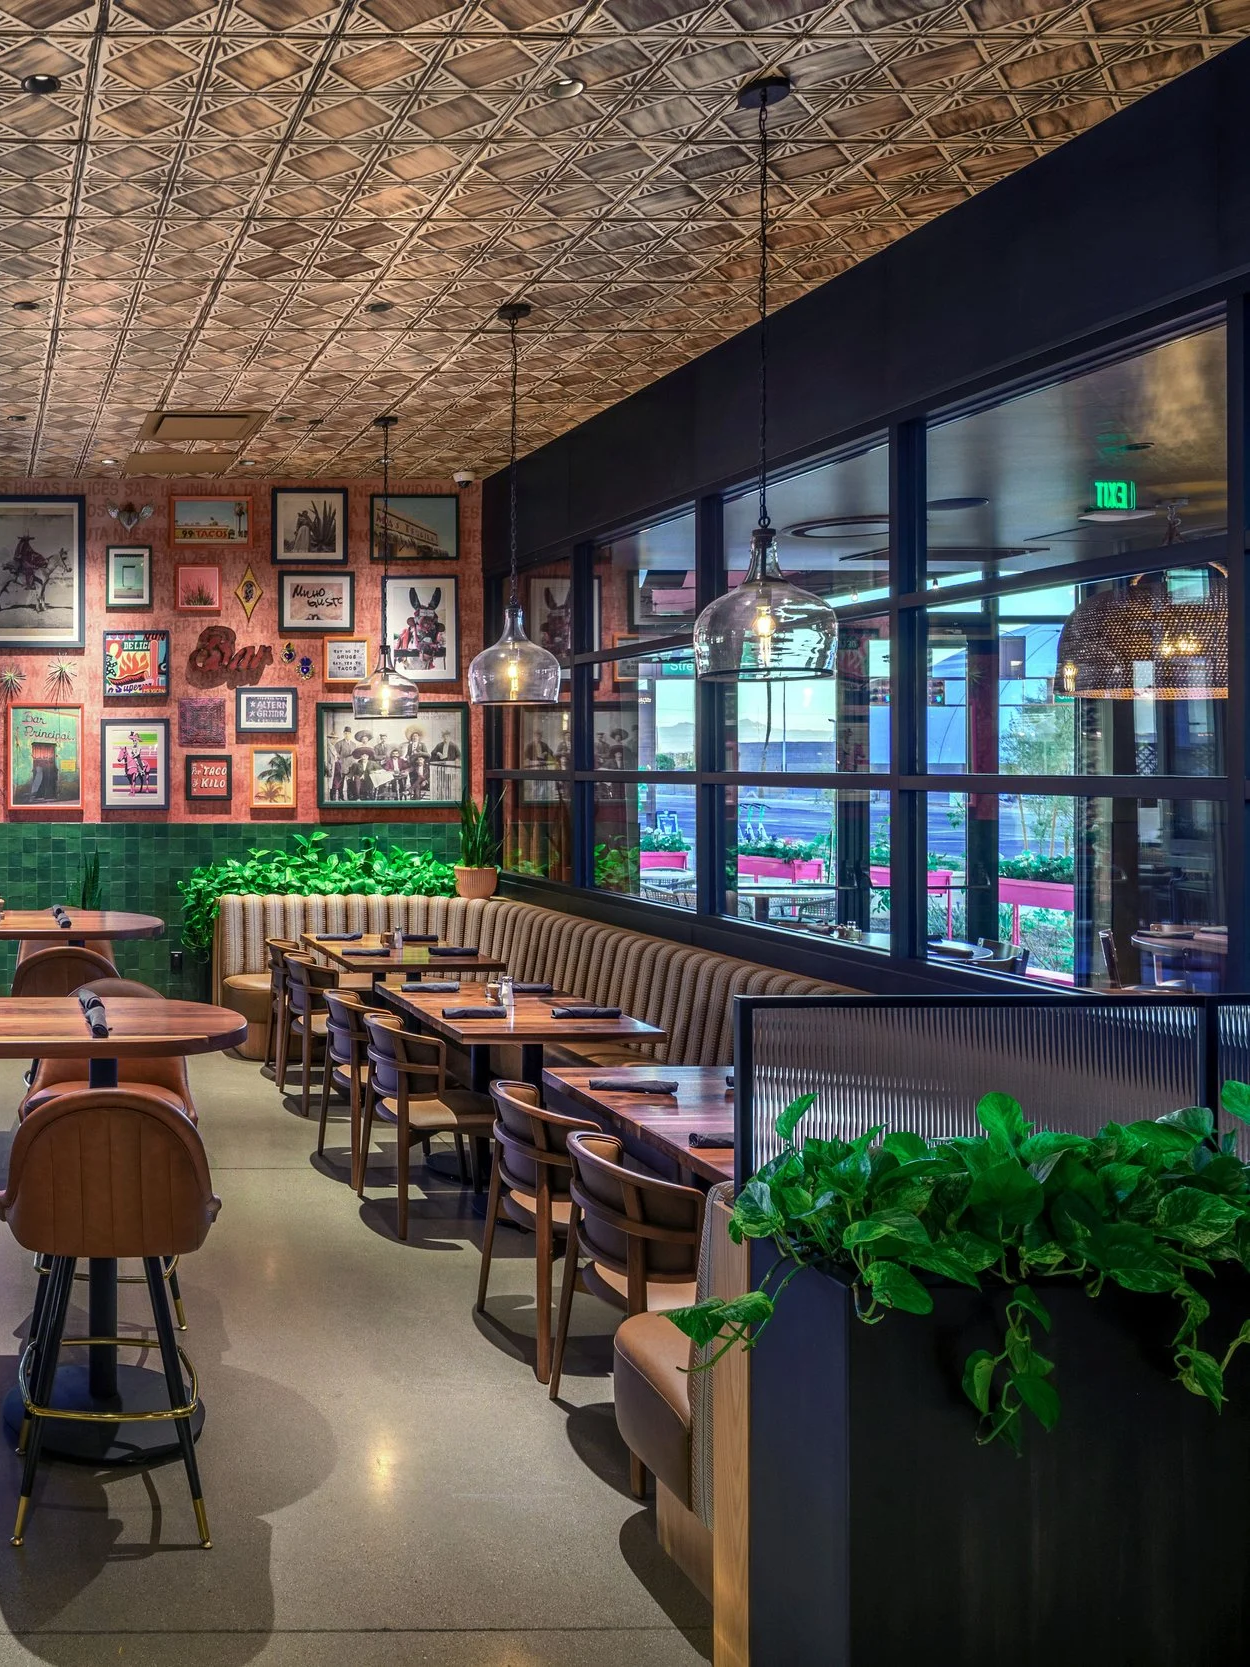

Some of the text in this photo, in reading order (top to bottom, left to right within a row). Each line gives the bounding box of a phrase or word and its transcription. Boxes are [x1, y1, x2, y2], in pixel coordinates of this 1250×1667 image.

[14, 480, 60, 495] HORAS
[181, 530, 227, 538] 99 TACOS
[22, 710, 47, 725] Bar
[201, 763, 227, 776] TACO
[201, 778, 226, 788] KILO
